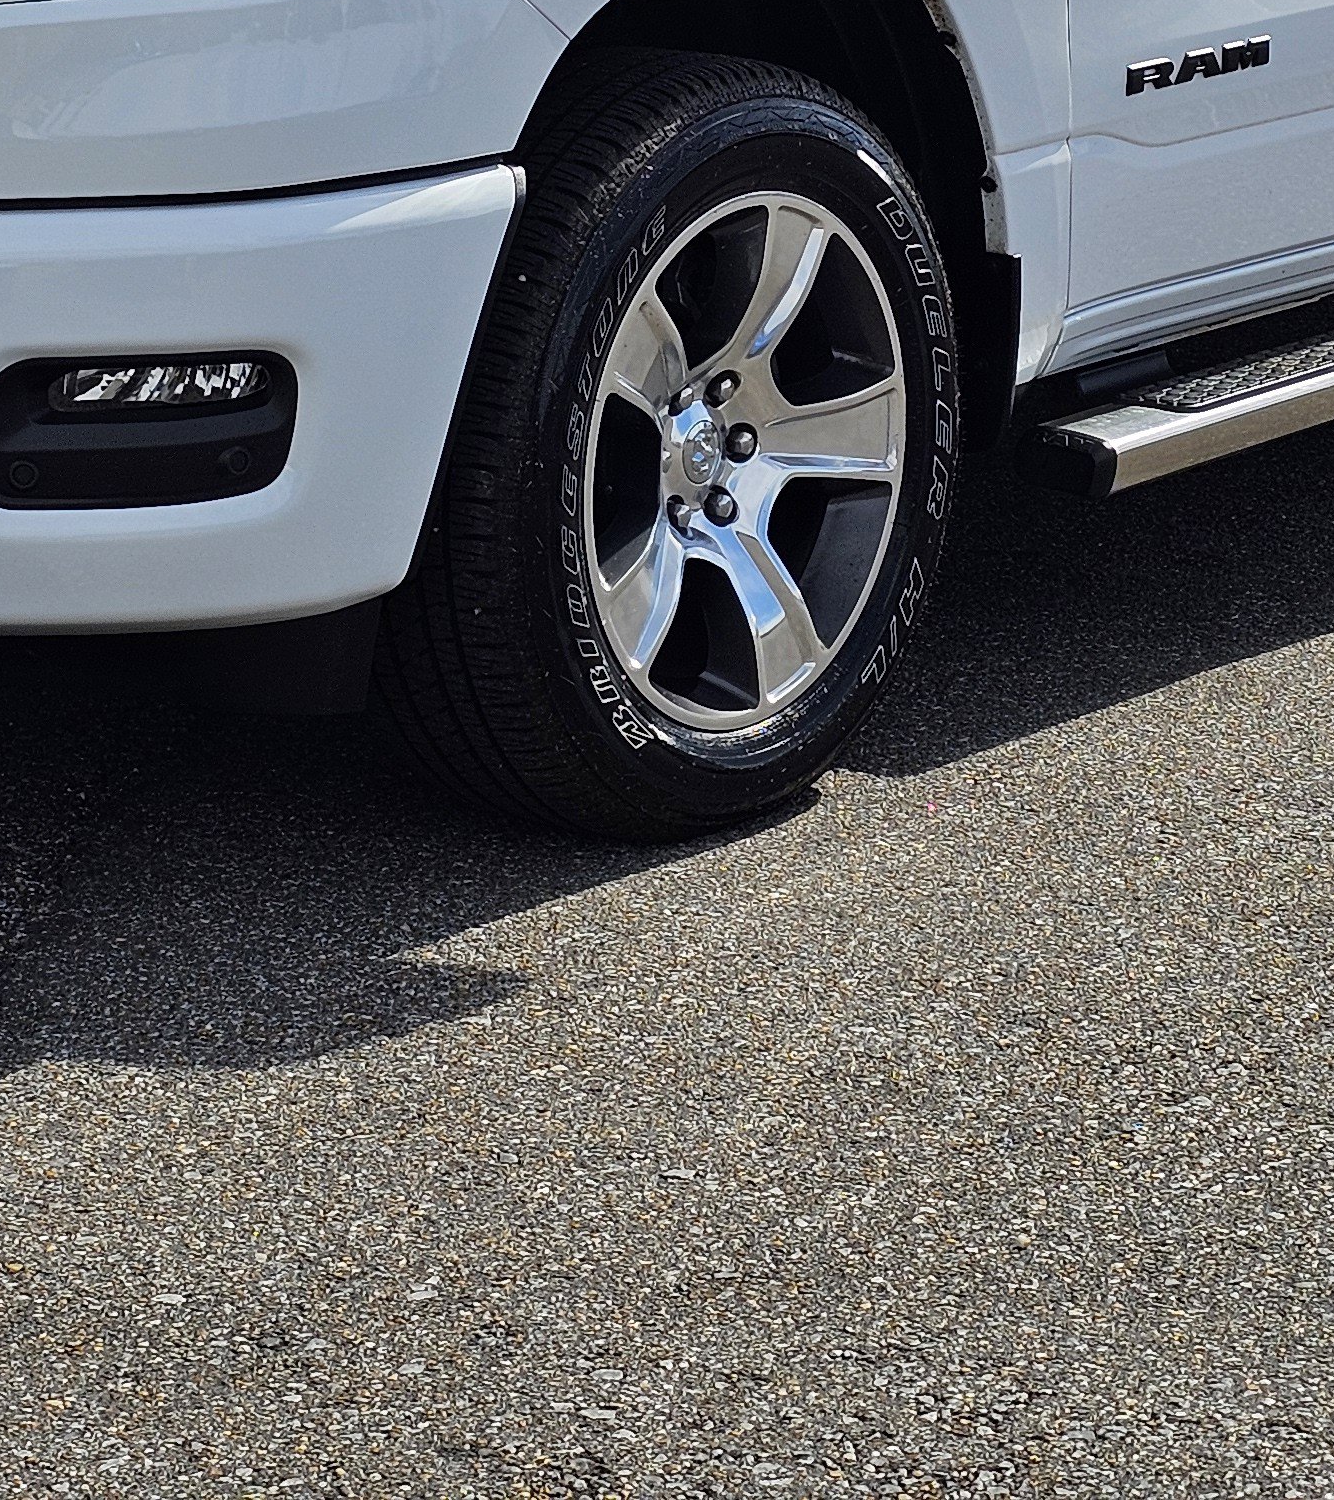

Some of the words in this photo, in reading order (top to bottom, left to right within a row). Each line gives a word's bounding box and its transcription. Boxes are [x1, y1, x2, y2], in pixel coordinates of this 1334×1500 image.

[1125, 34, 1272, 97] RAM
[561, 204, 666, 749] BRIDGESTONE
[876, 196, 954, 520] DUELER
